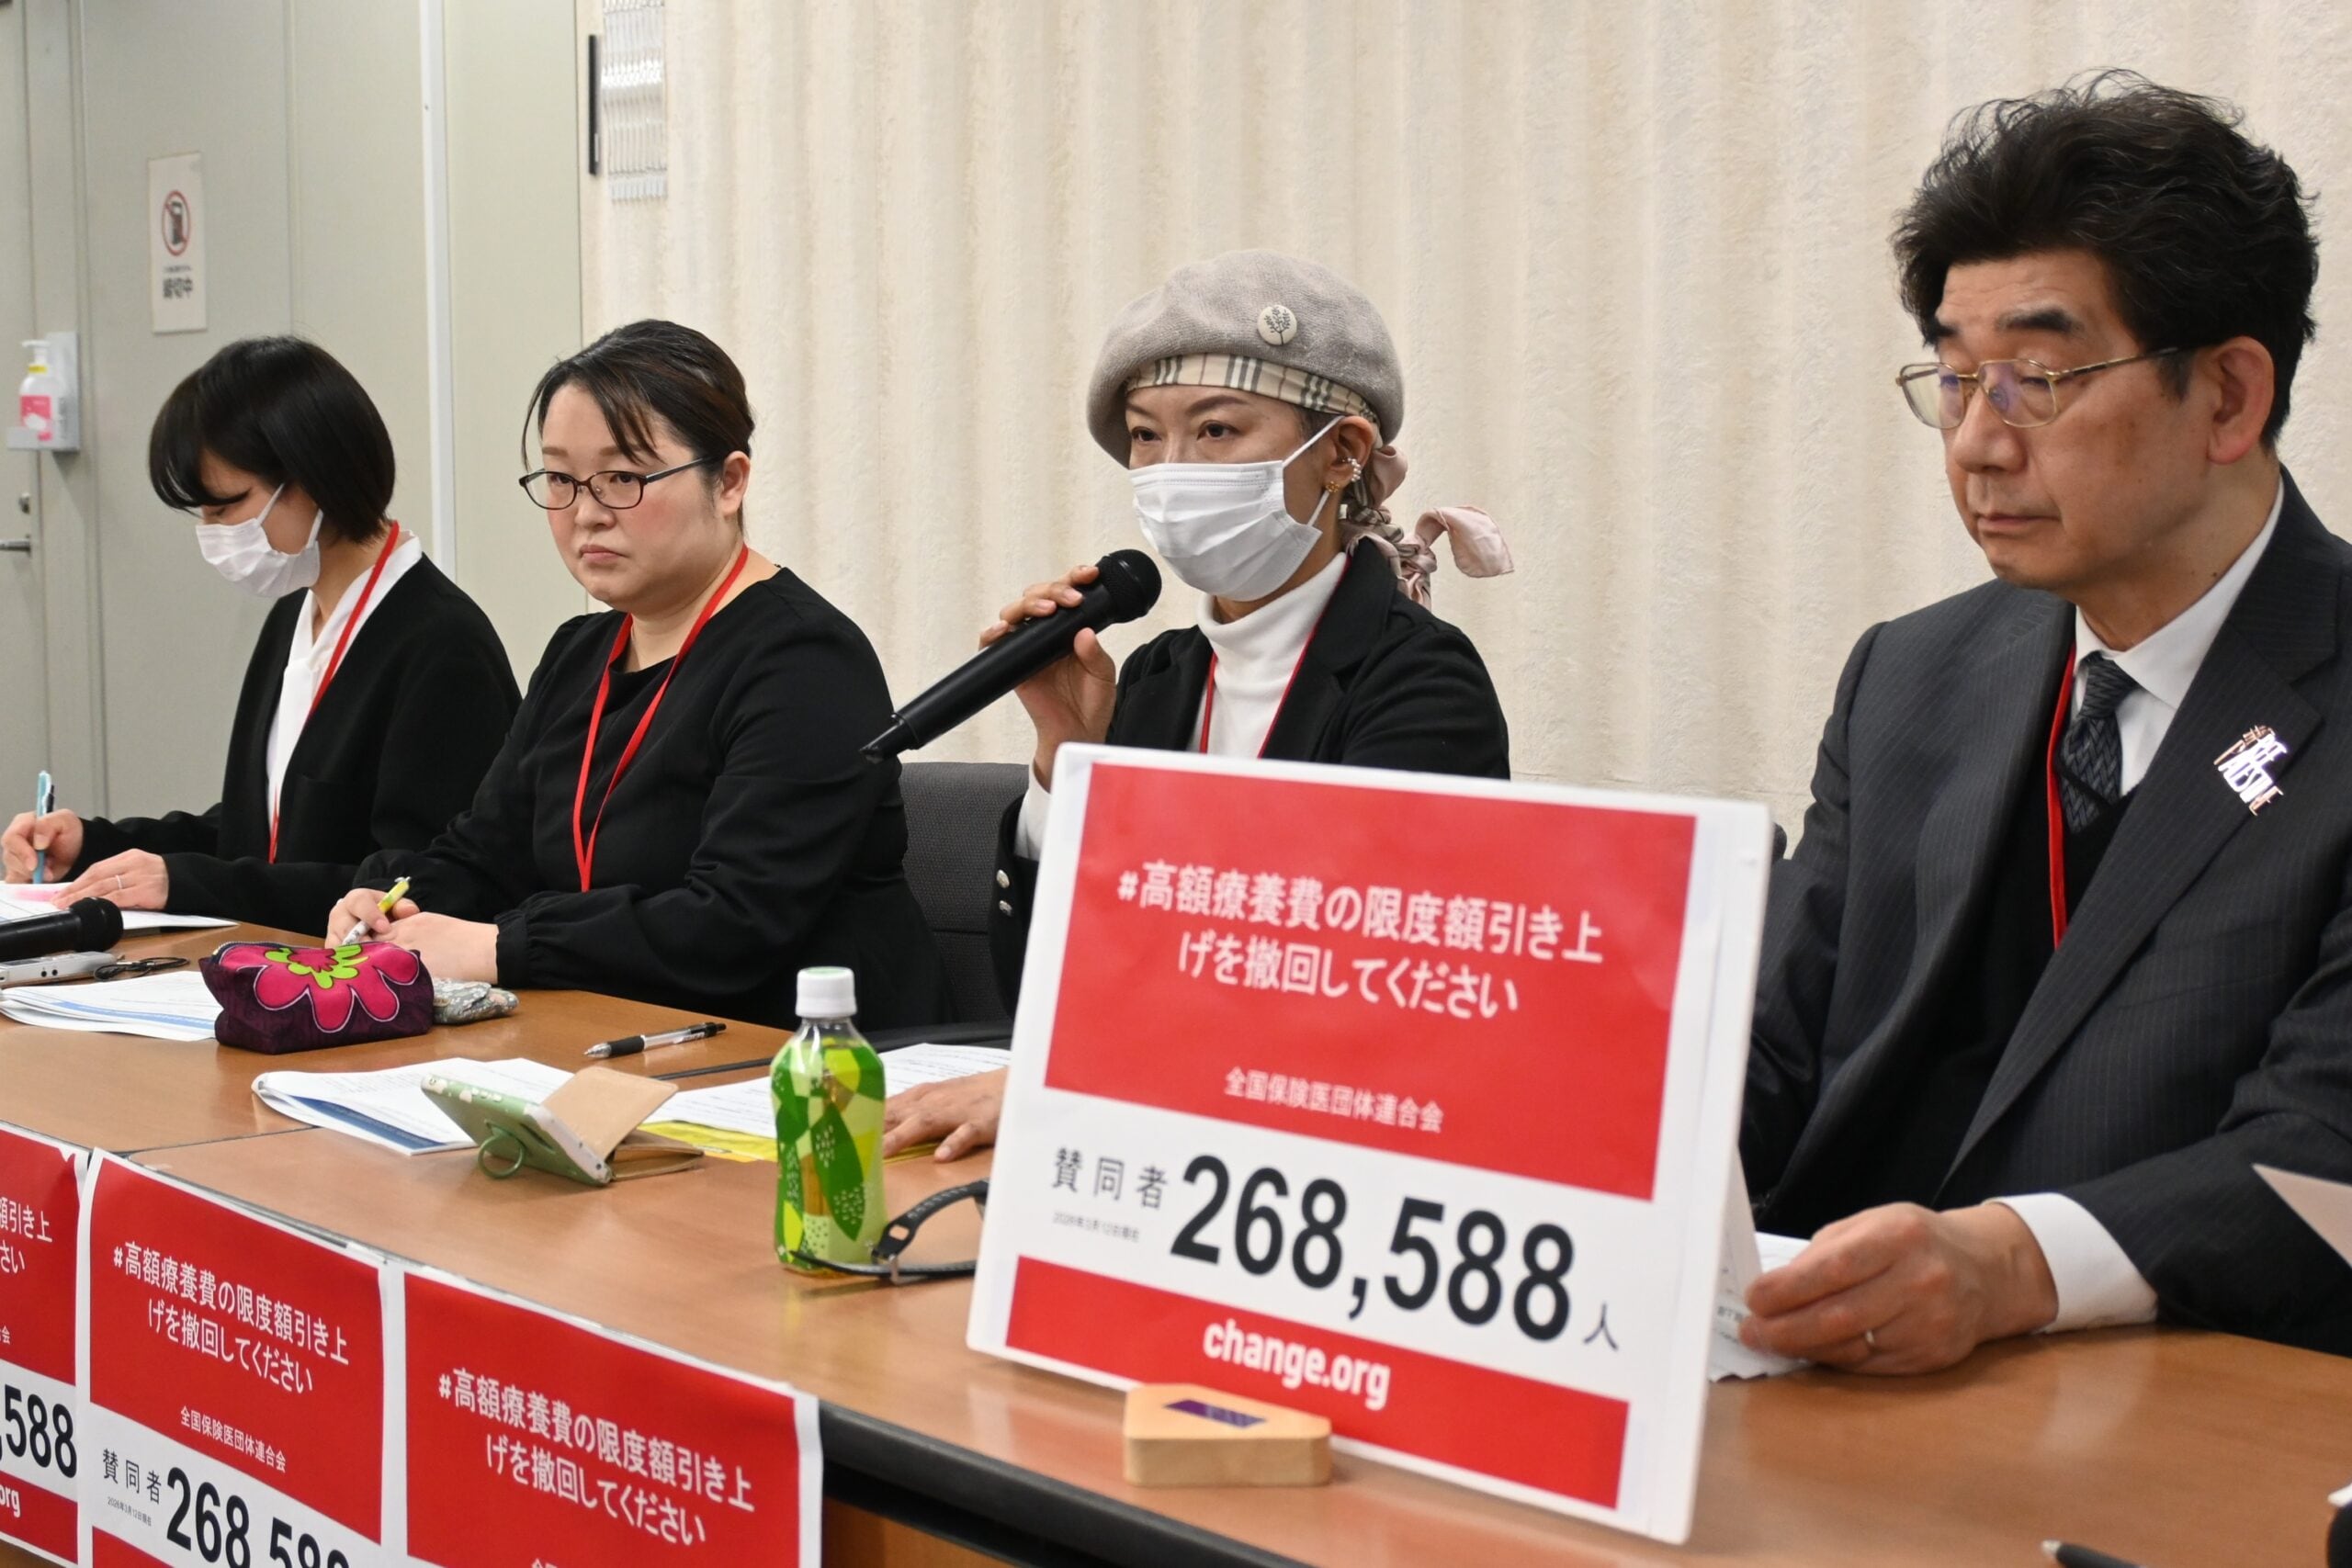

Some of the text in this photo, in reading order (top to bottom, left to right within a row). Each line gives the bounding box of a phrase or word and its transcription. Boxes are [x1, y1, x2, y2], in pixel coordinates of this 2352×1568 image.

[1116, 858, 1603, 964] #高額療養費の限度額引き上
[1178, 931, 1519, 1020] げを撤回してください
[1225, 1066, 1444, 1134] 全国保険医団体連合会
[1170, 1155, 1575, 1341] 268,588
[113, 1241, 349, 1365] #高額療養費の限度額引き上
[148, 1298, 313, 1393] げを撤回してください
[1203, 1317, 1391, 1412] change.org
[180, 1405, 286, 1473] 全国保険医団体連合会
[438, 1368, 754, 1512] #高額療養費の限度額引き上
[487, 1434, 706, 1545] げを撤回してください
